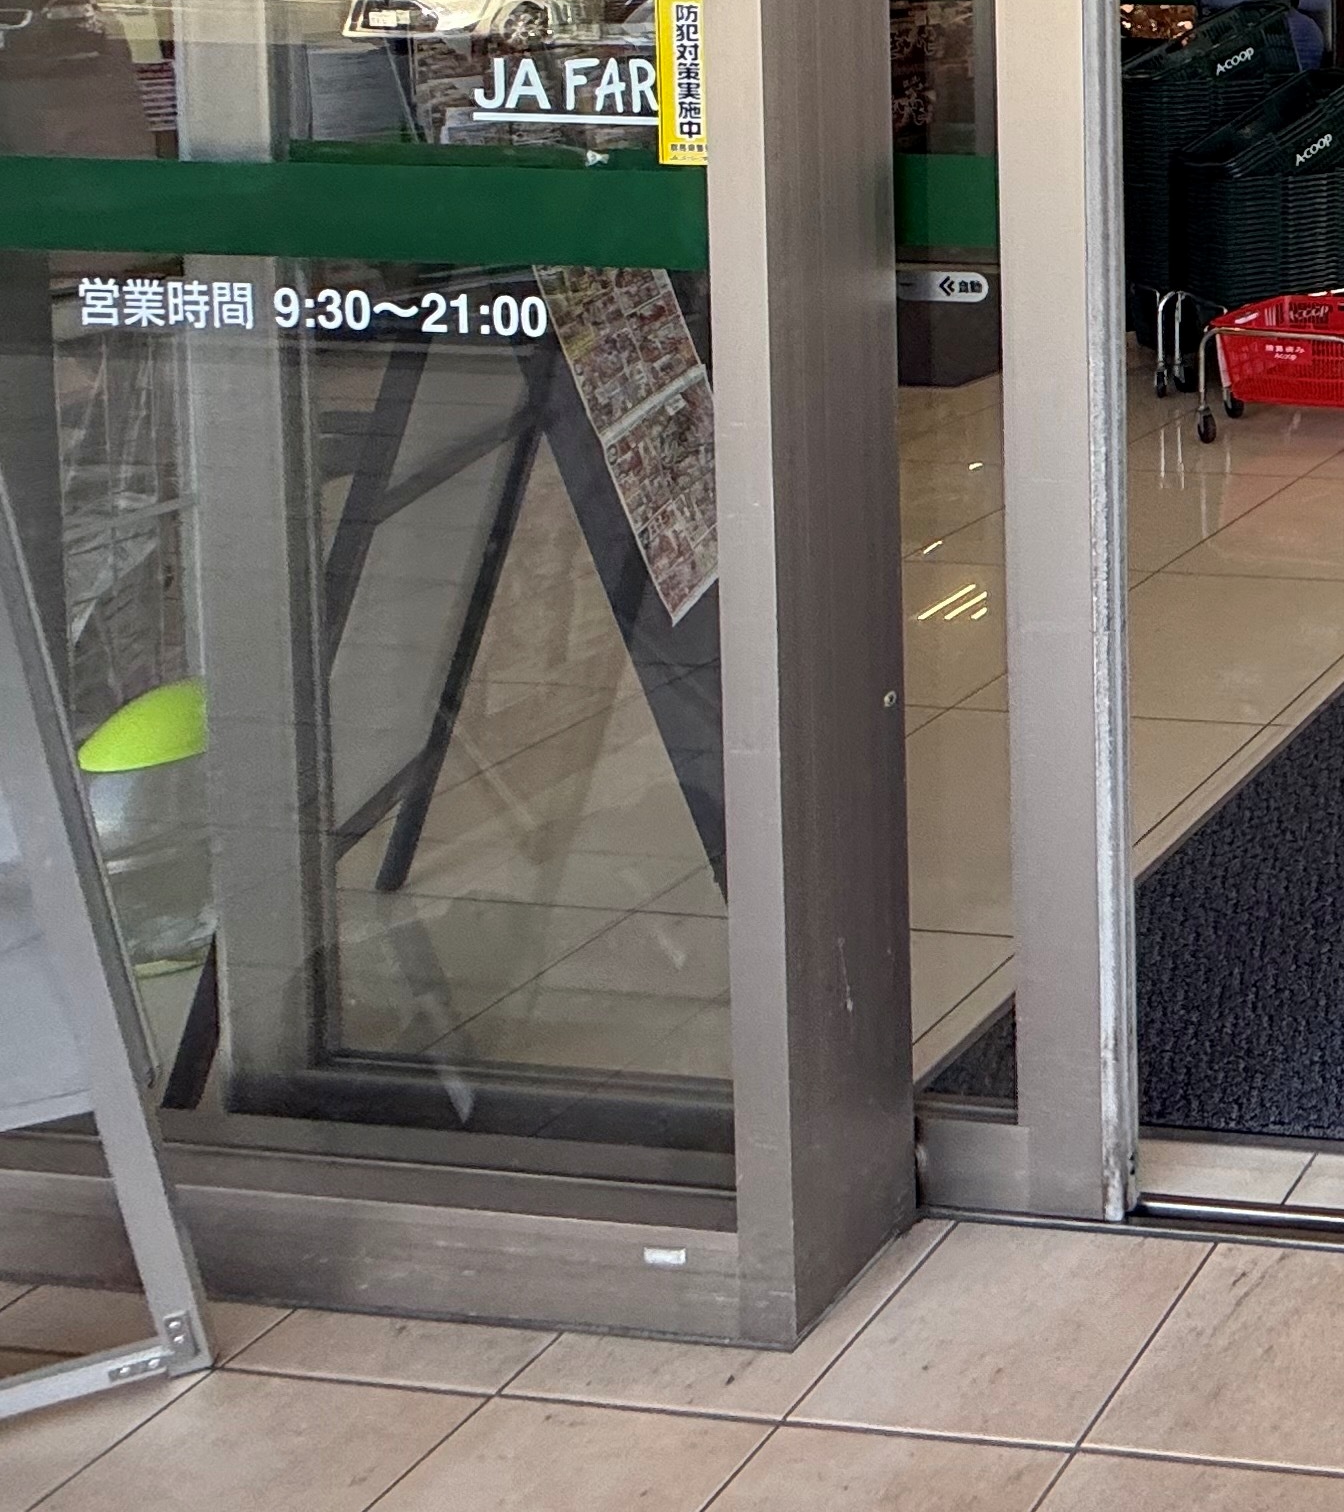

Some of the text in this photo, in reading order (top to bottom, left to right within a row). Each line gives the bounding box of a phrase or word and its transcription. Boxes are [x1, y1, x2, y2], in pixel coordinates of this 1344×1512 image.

[474, 57, 552, 110] JA
[675, 4, 702, 139] 防犯対策実施中
[78, 277, 254, 331] 営業時間
